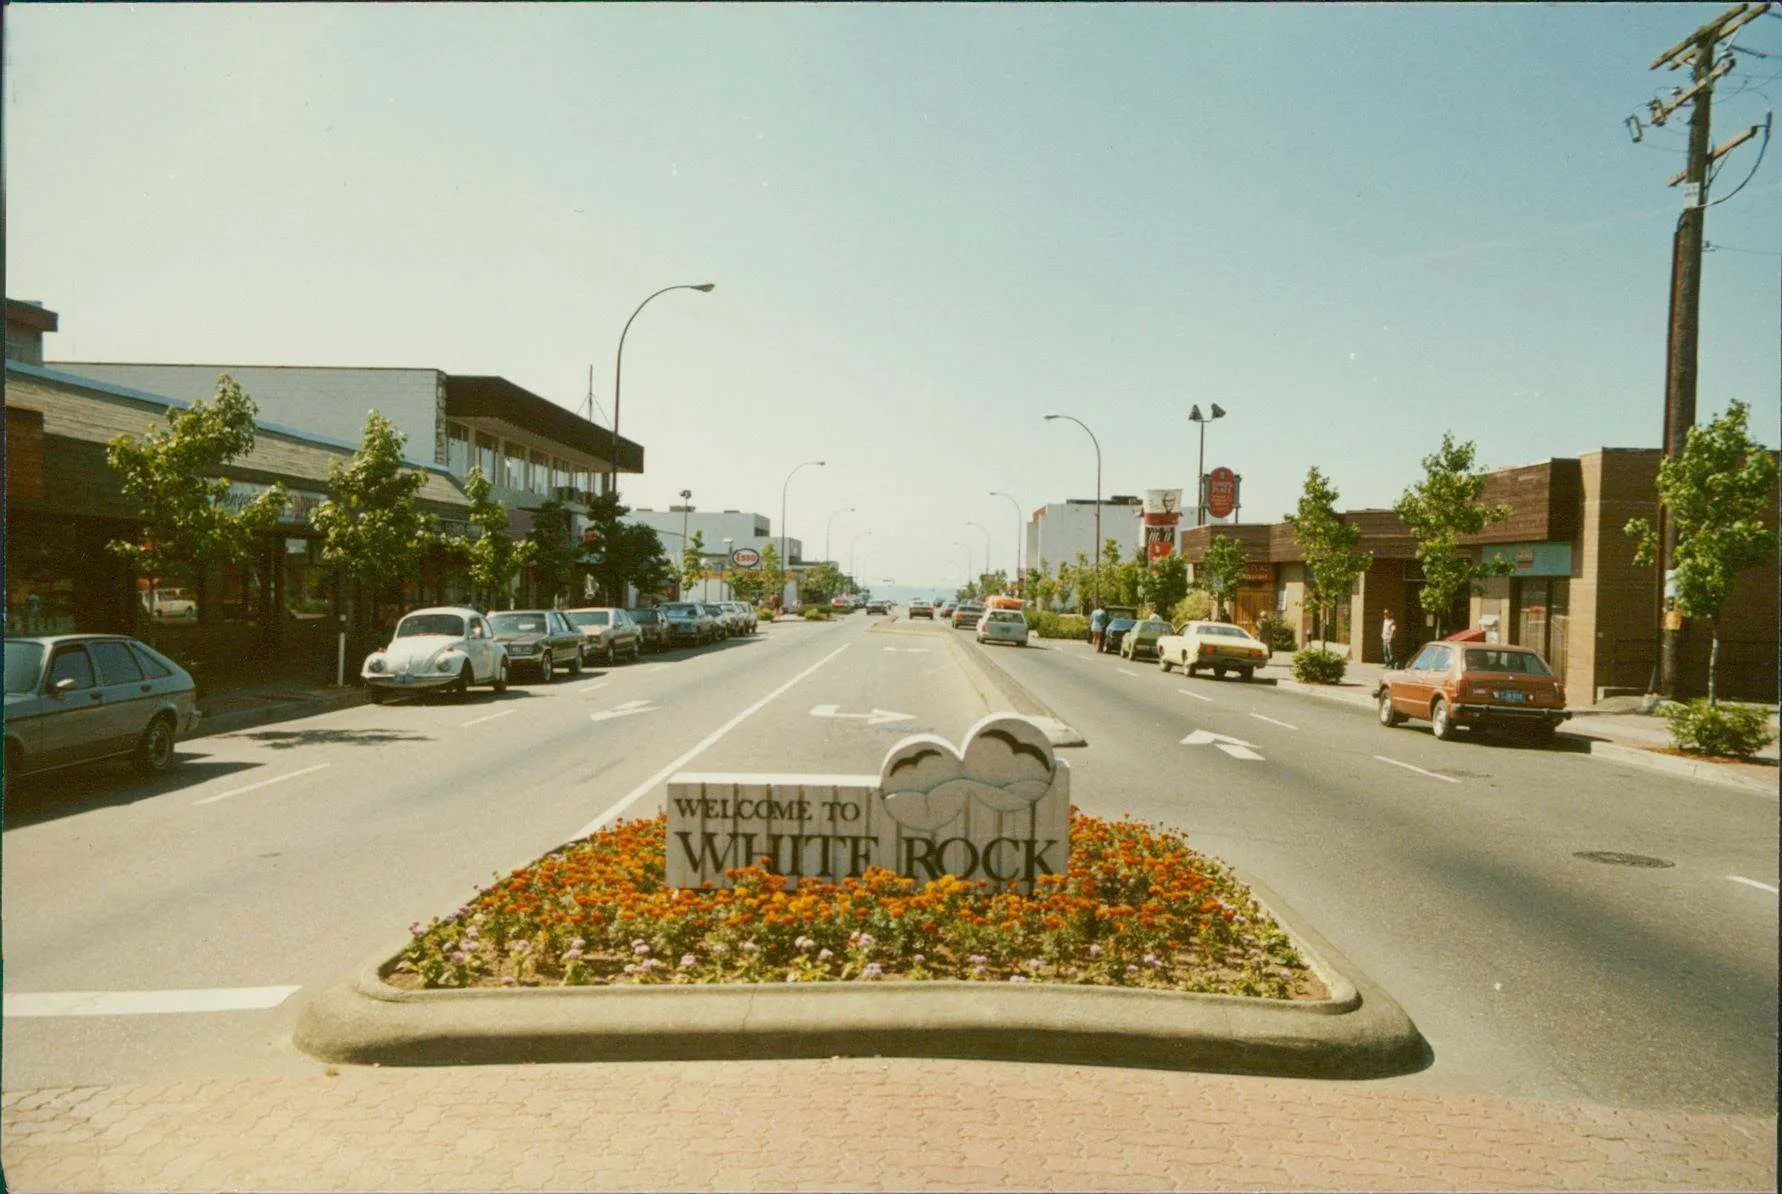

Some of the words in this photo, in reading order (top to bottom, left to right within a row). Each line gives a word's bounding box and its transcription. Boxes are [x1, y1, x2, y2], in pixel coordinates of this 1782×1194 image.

[736, 552, 757, 562] Esso
[673, 798, 813, 821] WELCOME
[822, 801, 861, 822] TO
[673, 831, 880, 877] WHITE
[899, 836, 1059, 883] ROCK
